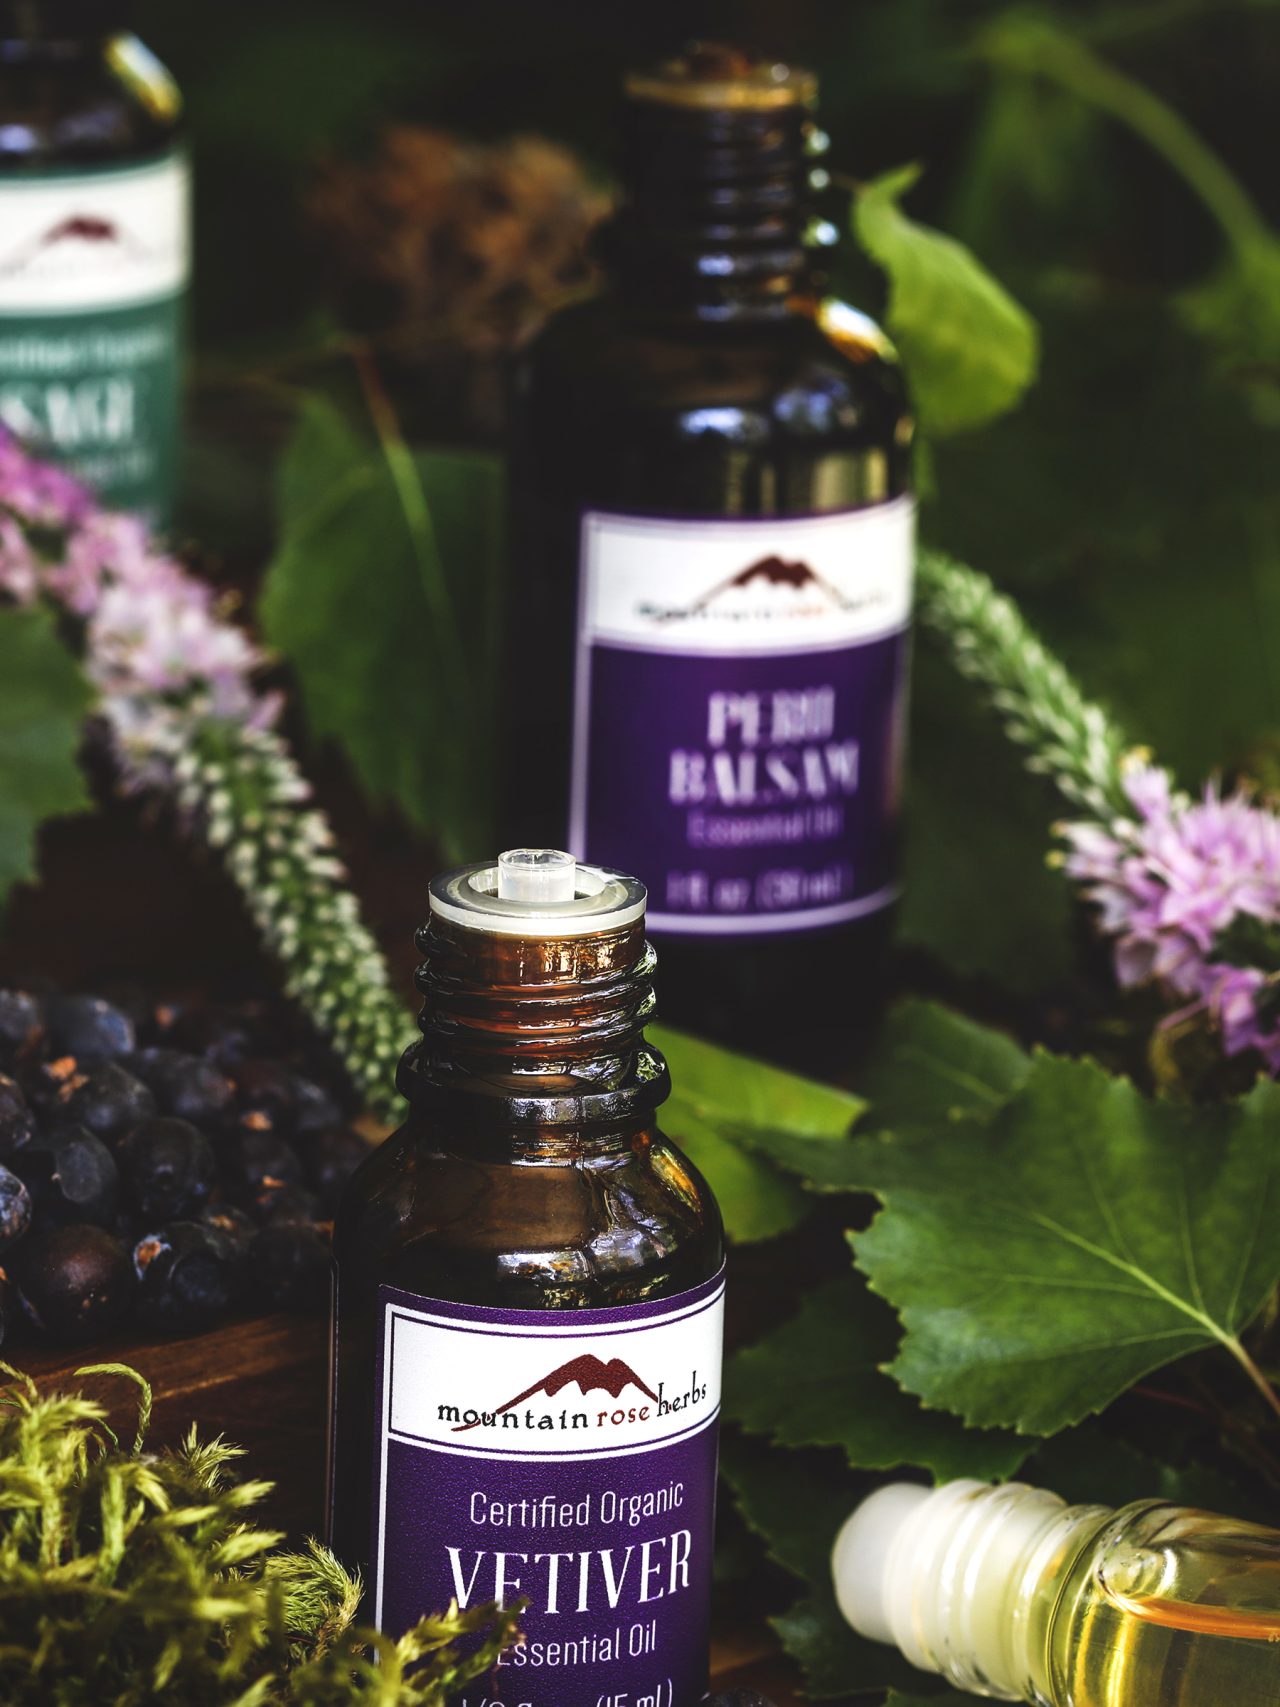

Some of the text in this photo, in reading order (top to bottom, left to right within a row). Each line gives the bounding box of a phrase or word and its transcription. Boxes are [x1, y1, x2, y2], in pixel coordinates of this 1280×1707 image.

[437, 1370, 708, 1430] mountain rose herbs
[470, 1480, 685, 1528] Certified Organic
[444, 1529, 693, 1615] VETIVER
[629, 1619, 657, 1657] Oil
